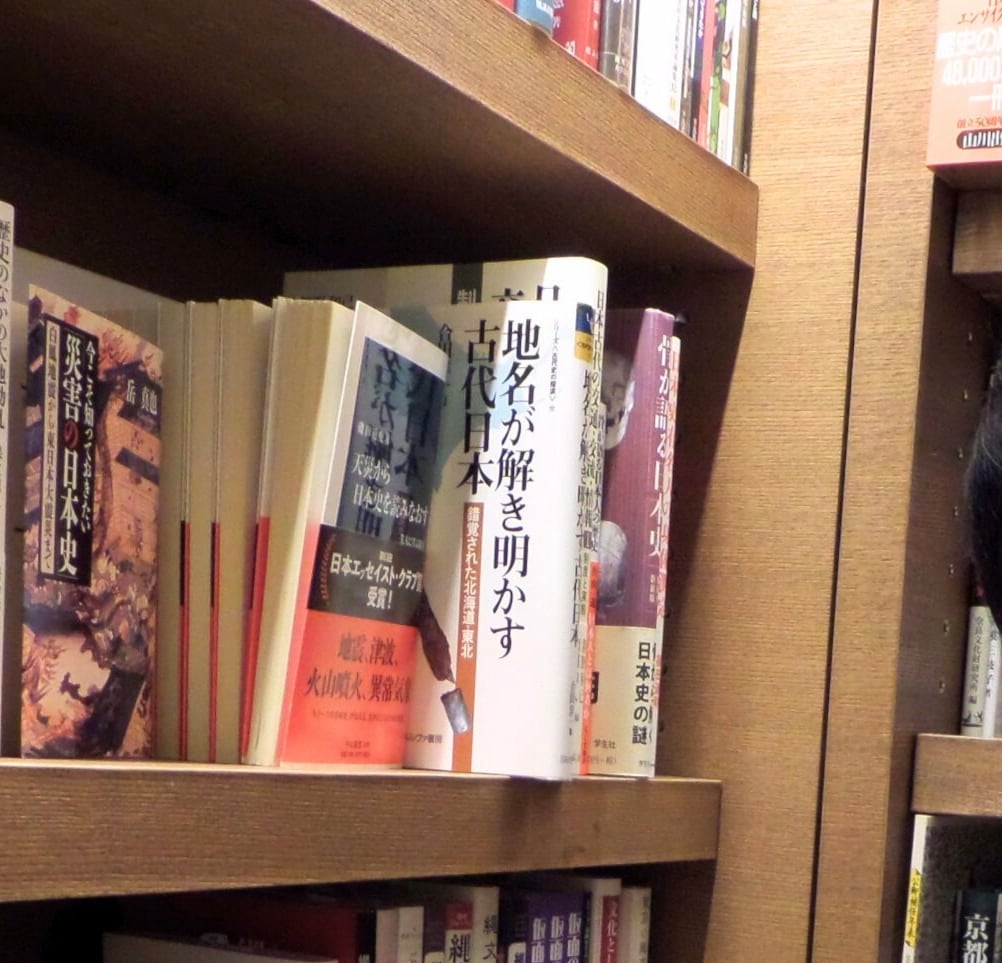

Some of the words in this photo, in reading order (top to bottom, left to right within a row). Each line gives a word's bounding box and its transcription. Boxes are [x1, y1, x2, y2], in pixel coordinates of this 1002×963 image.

[353, 453, 391, 484] 天災から
[456, 318, 502, 496] 古代日本
[489, 317, 542, 659] 地名が解き明かす
[459, 505, 483, 658] 錯覚された北海道・東北
[631, 642, 656, 745] 日本史の謎
